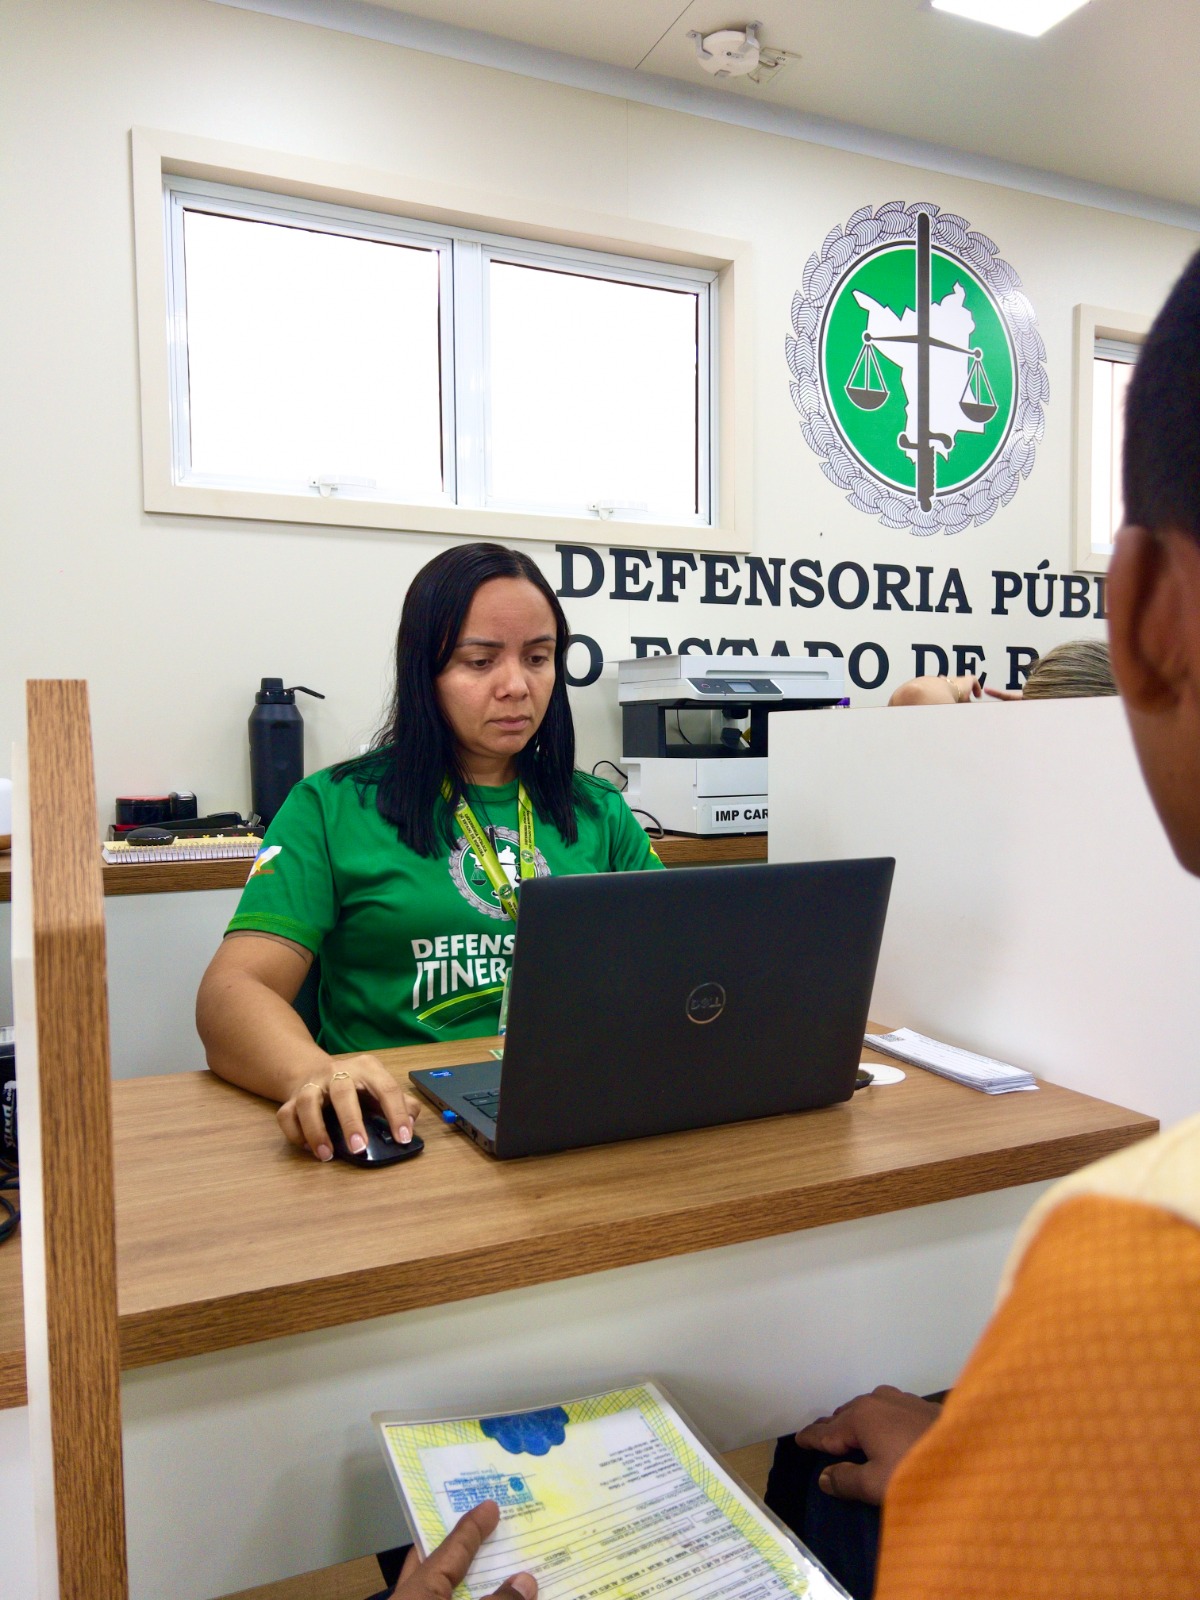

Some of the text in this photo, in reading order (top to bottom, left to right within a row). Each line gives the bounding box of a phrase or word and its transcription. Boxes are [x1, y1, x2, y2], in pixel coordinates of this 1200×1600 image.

[554, 543, 973, 615] DEFENSORIA
[911, 643, 988, 690] DE
[715, 808, 768, 822] IMP CAR
[411, 934, 516, 959] DEFENS
[412, 957, 507, 1010] ITINER
